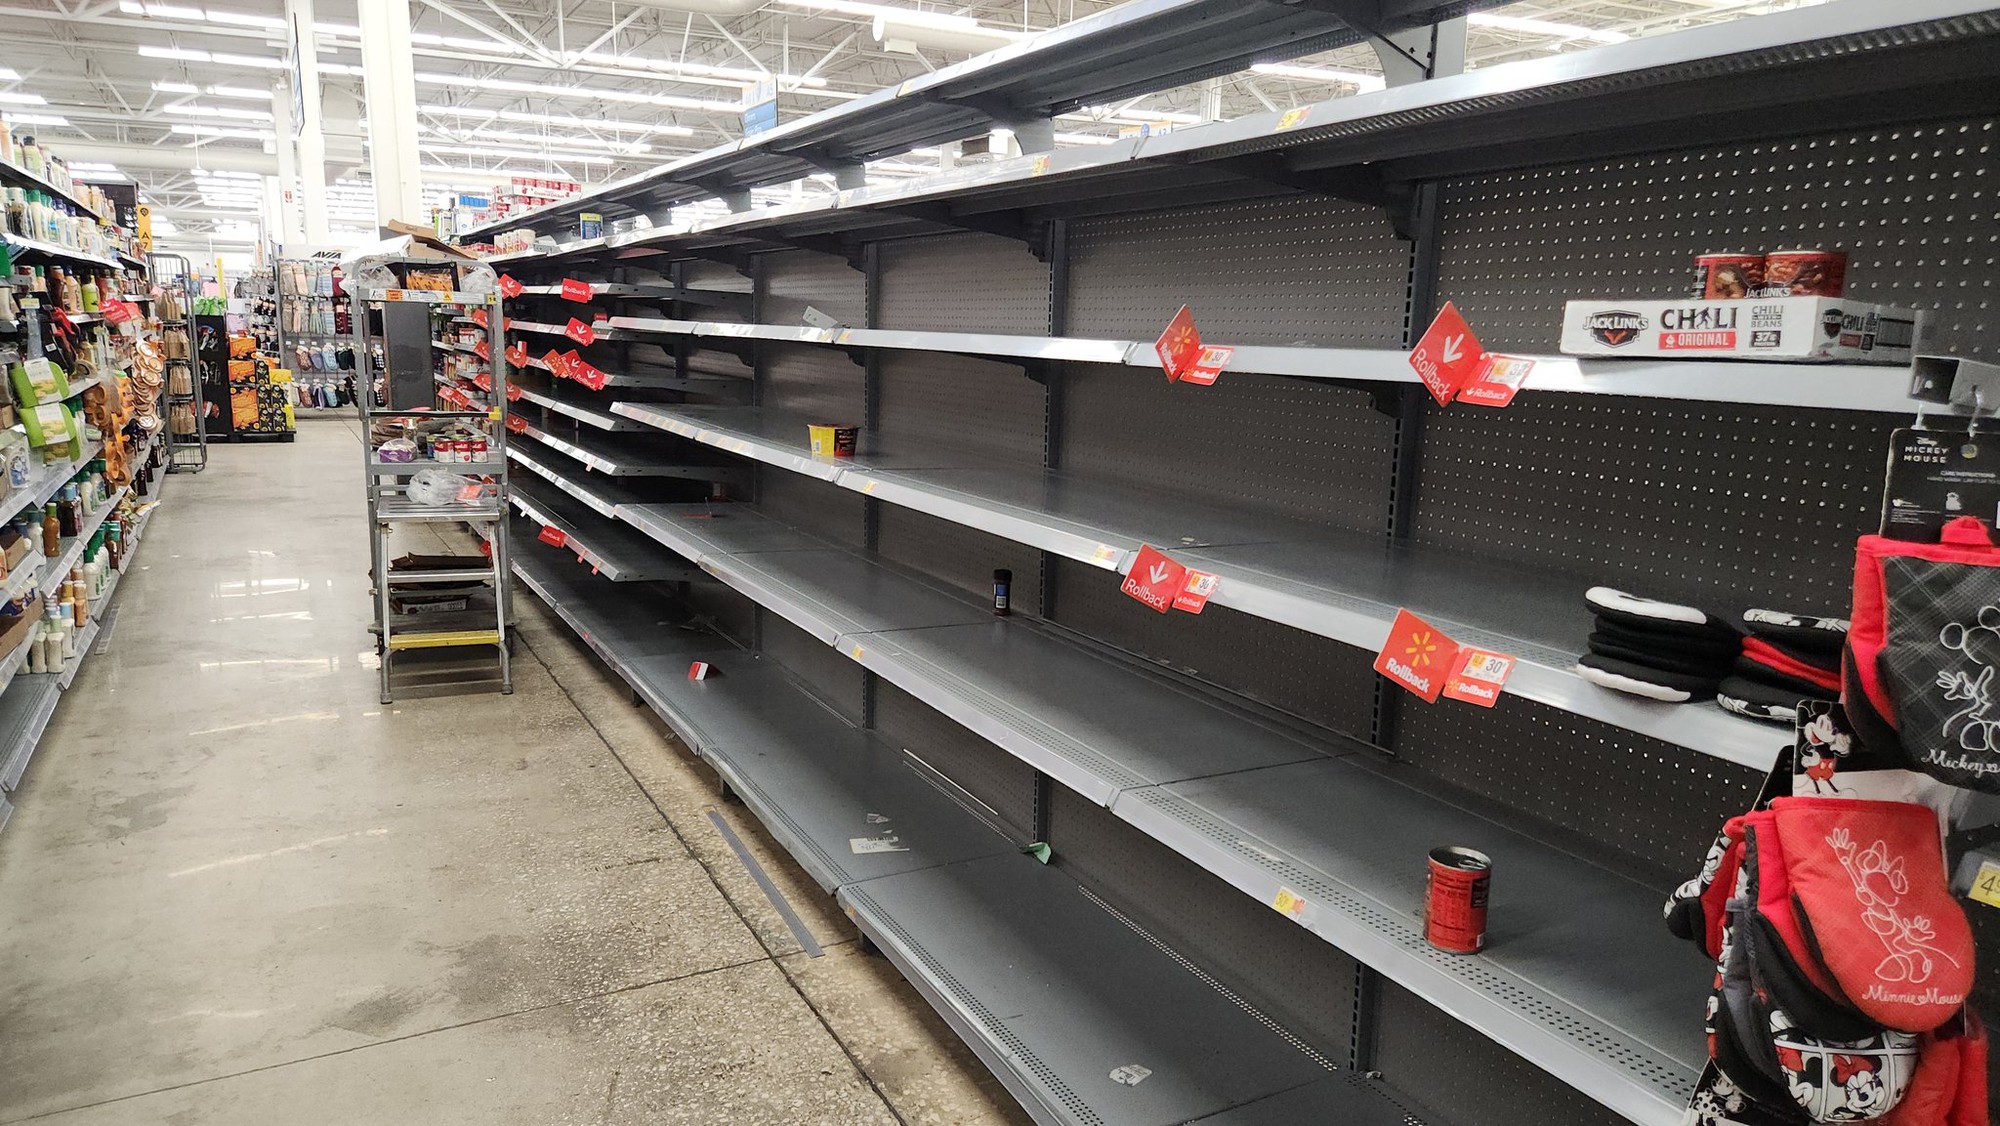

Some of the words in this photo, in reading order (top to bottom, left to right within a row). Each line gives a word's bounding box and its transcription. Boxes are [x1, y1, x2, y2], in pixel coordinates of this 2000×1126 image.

[141, 231, 150, 239] A
[311, 251, 341, 259] AVIA
[563, 285, 586, 295] Rollback
[1752, 305, 1784, 314] CHILI
[1583, 316, 1614, 331] JACK
[1751, 320, 1782, 328] BEANS
[1678, 332, 1729, 347] ORIGINAL
[1413, 348, 1450, 400] Rollback
[1904, 446, 1949, 455] MICKEY
[1903, 455, 1947, 464] MOUSE
[1125, 578, 1167, 610] Rollback
[1385, 657, 1430, 694] Rollback
[1458, 682, 1494, 699] Rollback
[1921, 748, 1984, 779] Mickey
[1862, 984, 1917, 1004] Minnie
